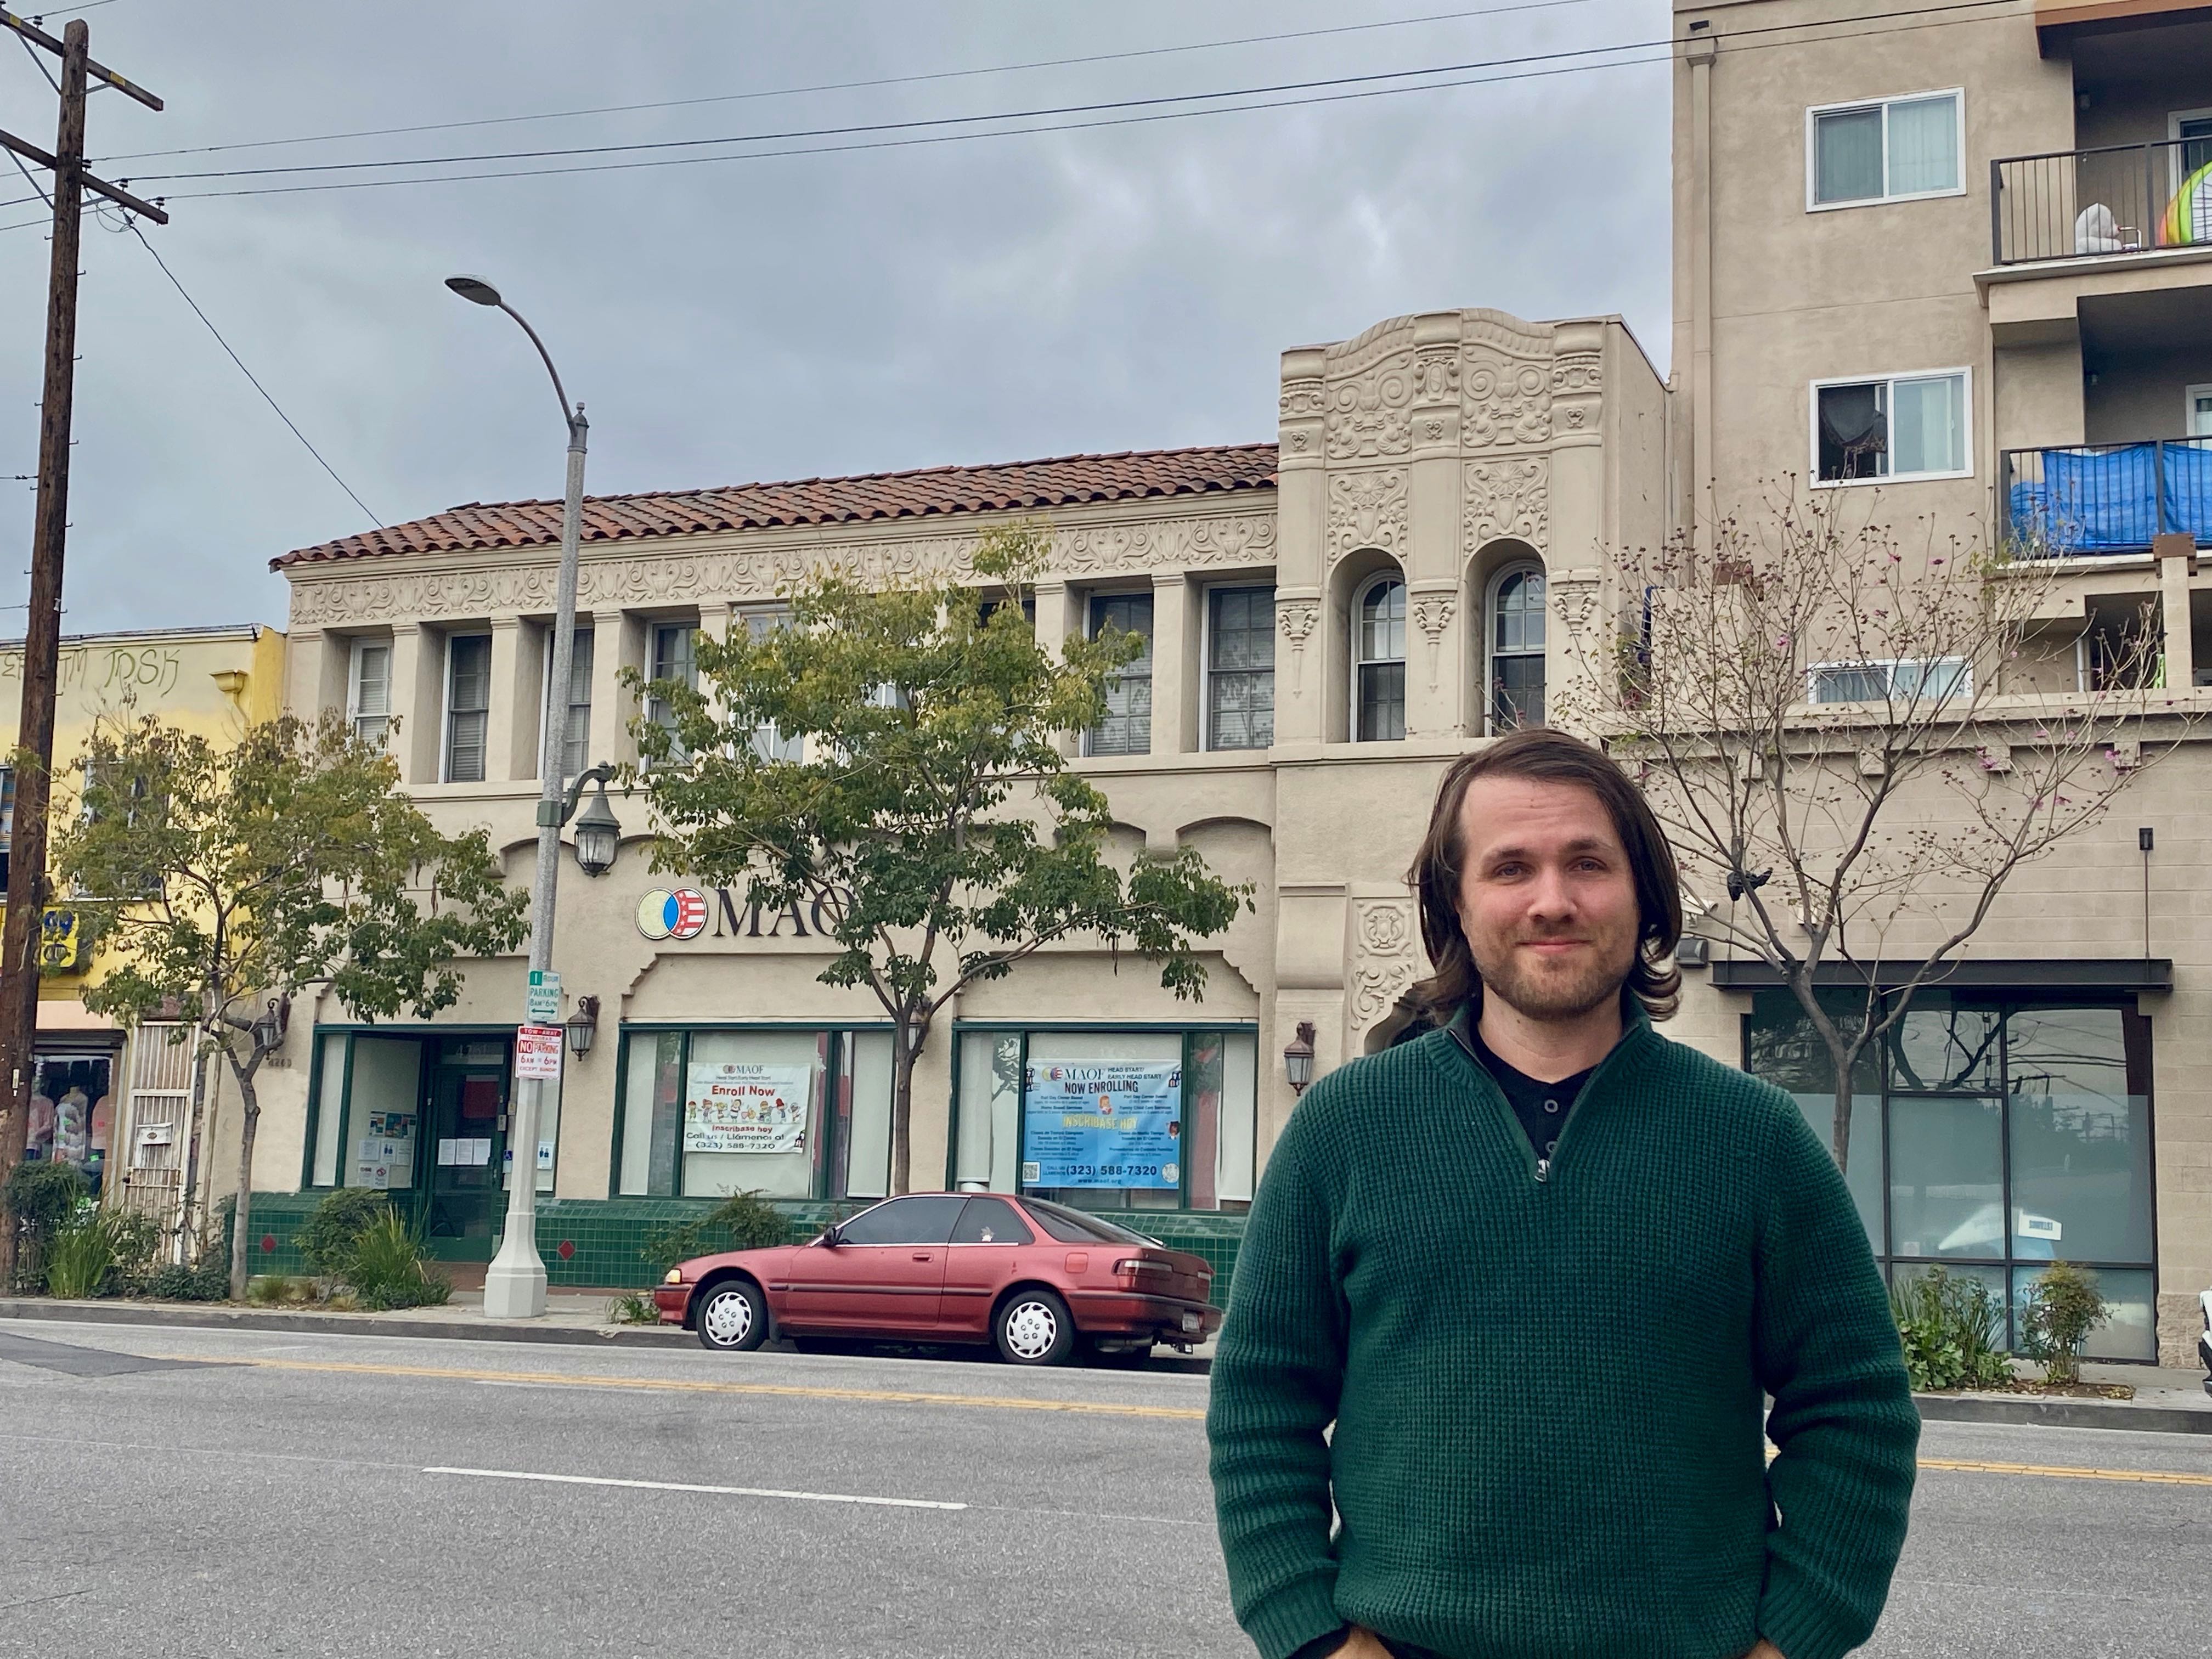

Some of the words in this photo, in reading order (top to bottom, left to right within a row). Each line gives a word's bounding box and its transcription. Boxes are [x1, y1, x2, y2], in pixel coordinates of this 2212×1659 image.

[712, 876, 857, 936] MAO
[530, 988, 558, 998] PARKING
[520, 1041, 533, 1053] NO
[736, 1065, 764, 1074] MAOF
[1065, 1069, 1105, 1080] MAOF
[712, 1085, 745, 1096] Enroll
[749, 1086, 776, 1096] Now
[1065, 1082, 1085, 1094] NOW
[1088, 1081, 1138, 1094] ENROLLING
[696, 1141, 723, 1149] (323)
[1066, 1165, 1096, 1176] (323)
[1101, 1166, 1157, 1176] 588-7320
